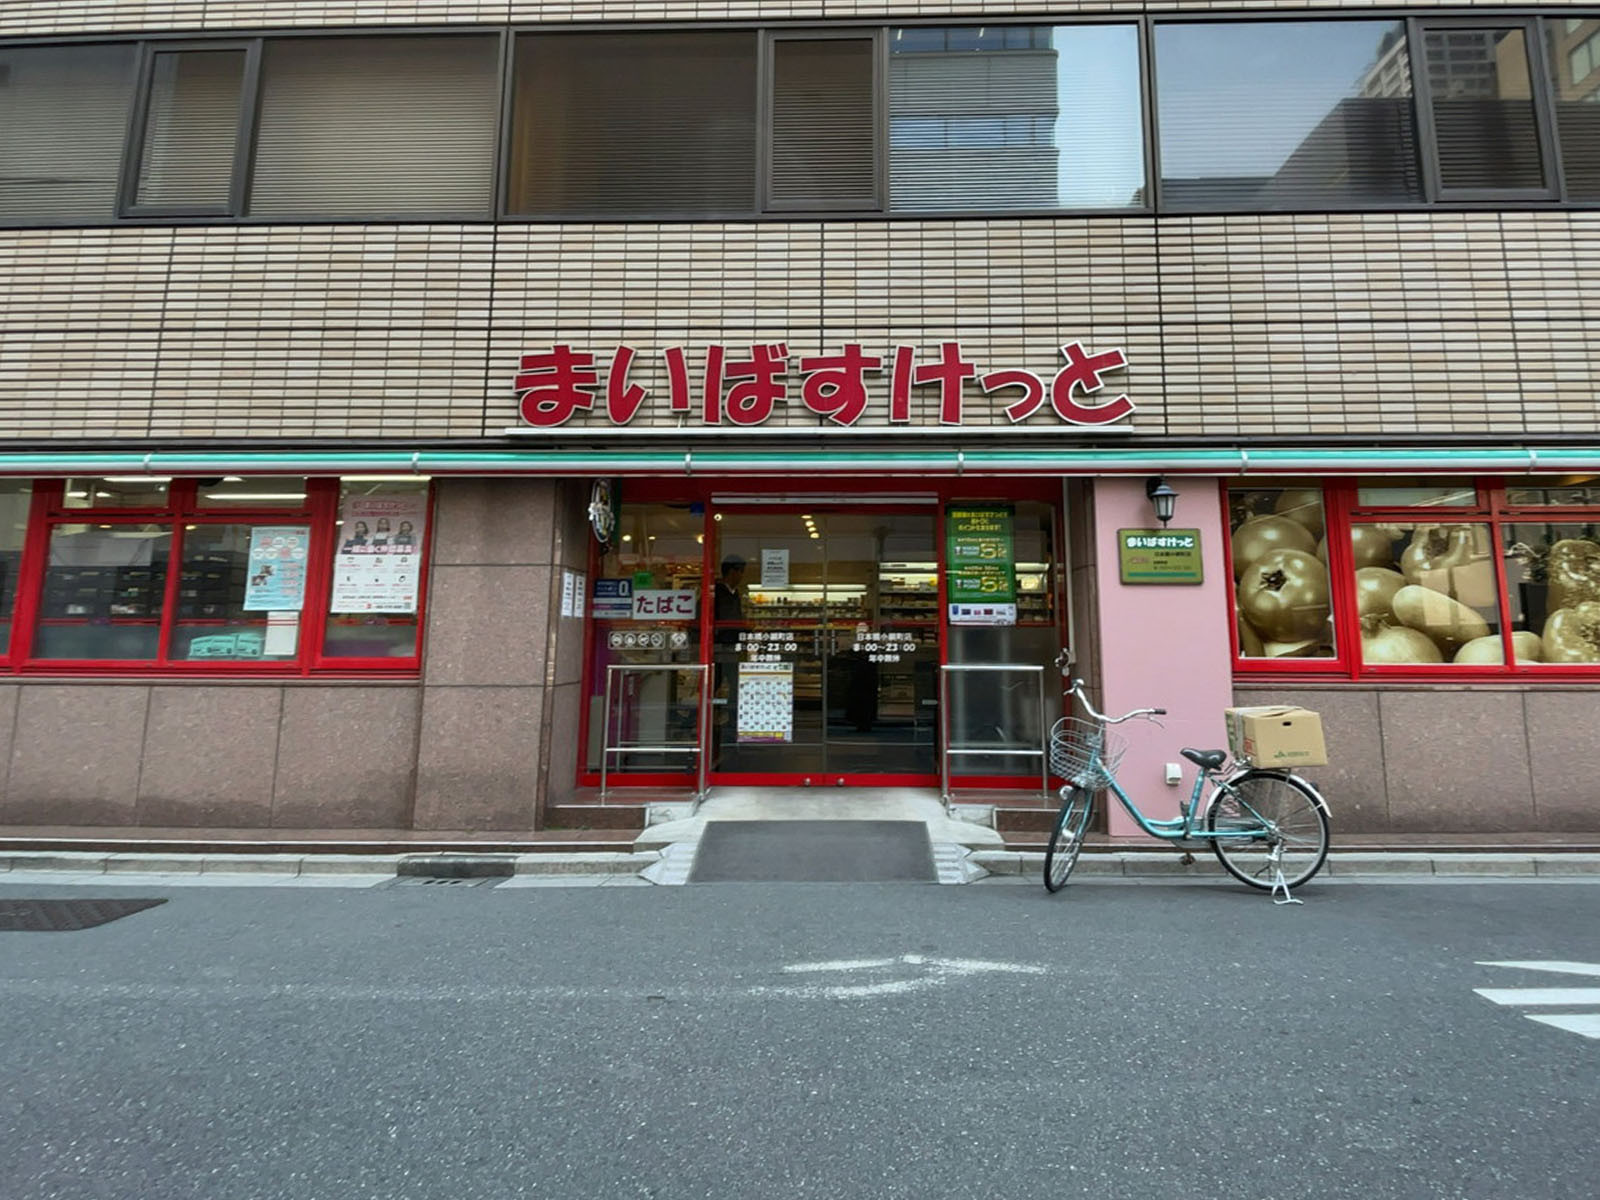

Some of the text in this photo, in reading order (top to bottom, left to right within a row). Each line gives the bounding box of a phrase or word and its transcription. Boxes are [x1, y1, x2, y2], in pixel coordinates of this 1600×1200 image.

[512, 339, 1137, 428] まいばすけっと
[636, 595, 693, 614] たばこ
